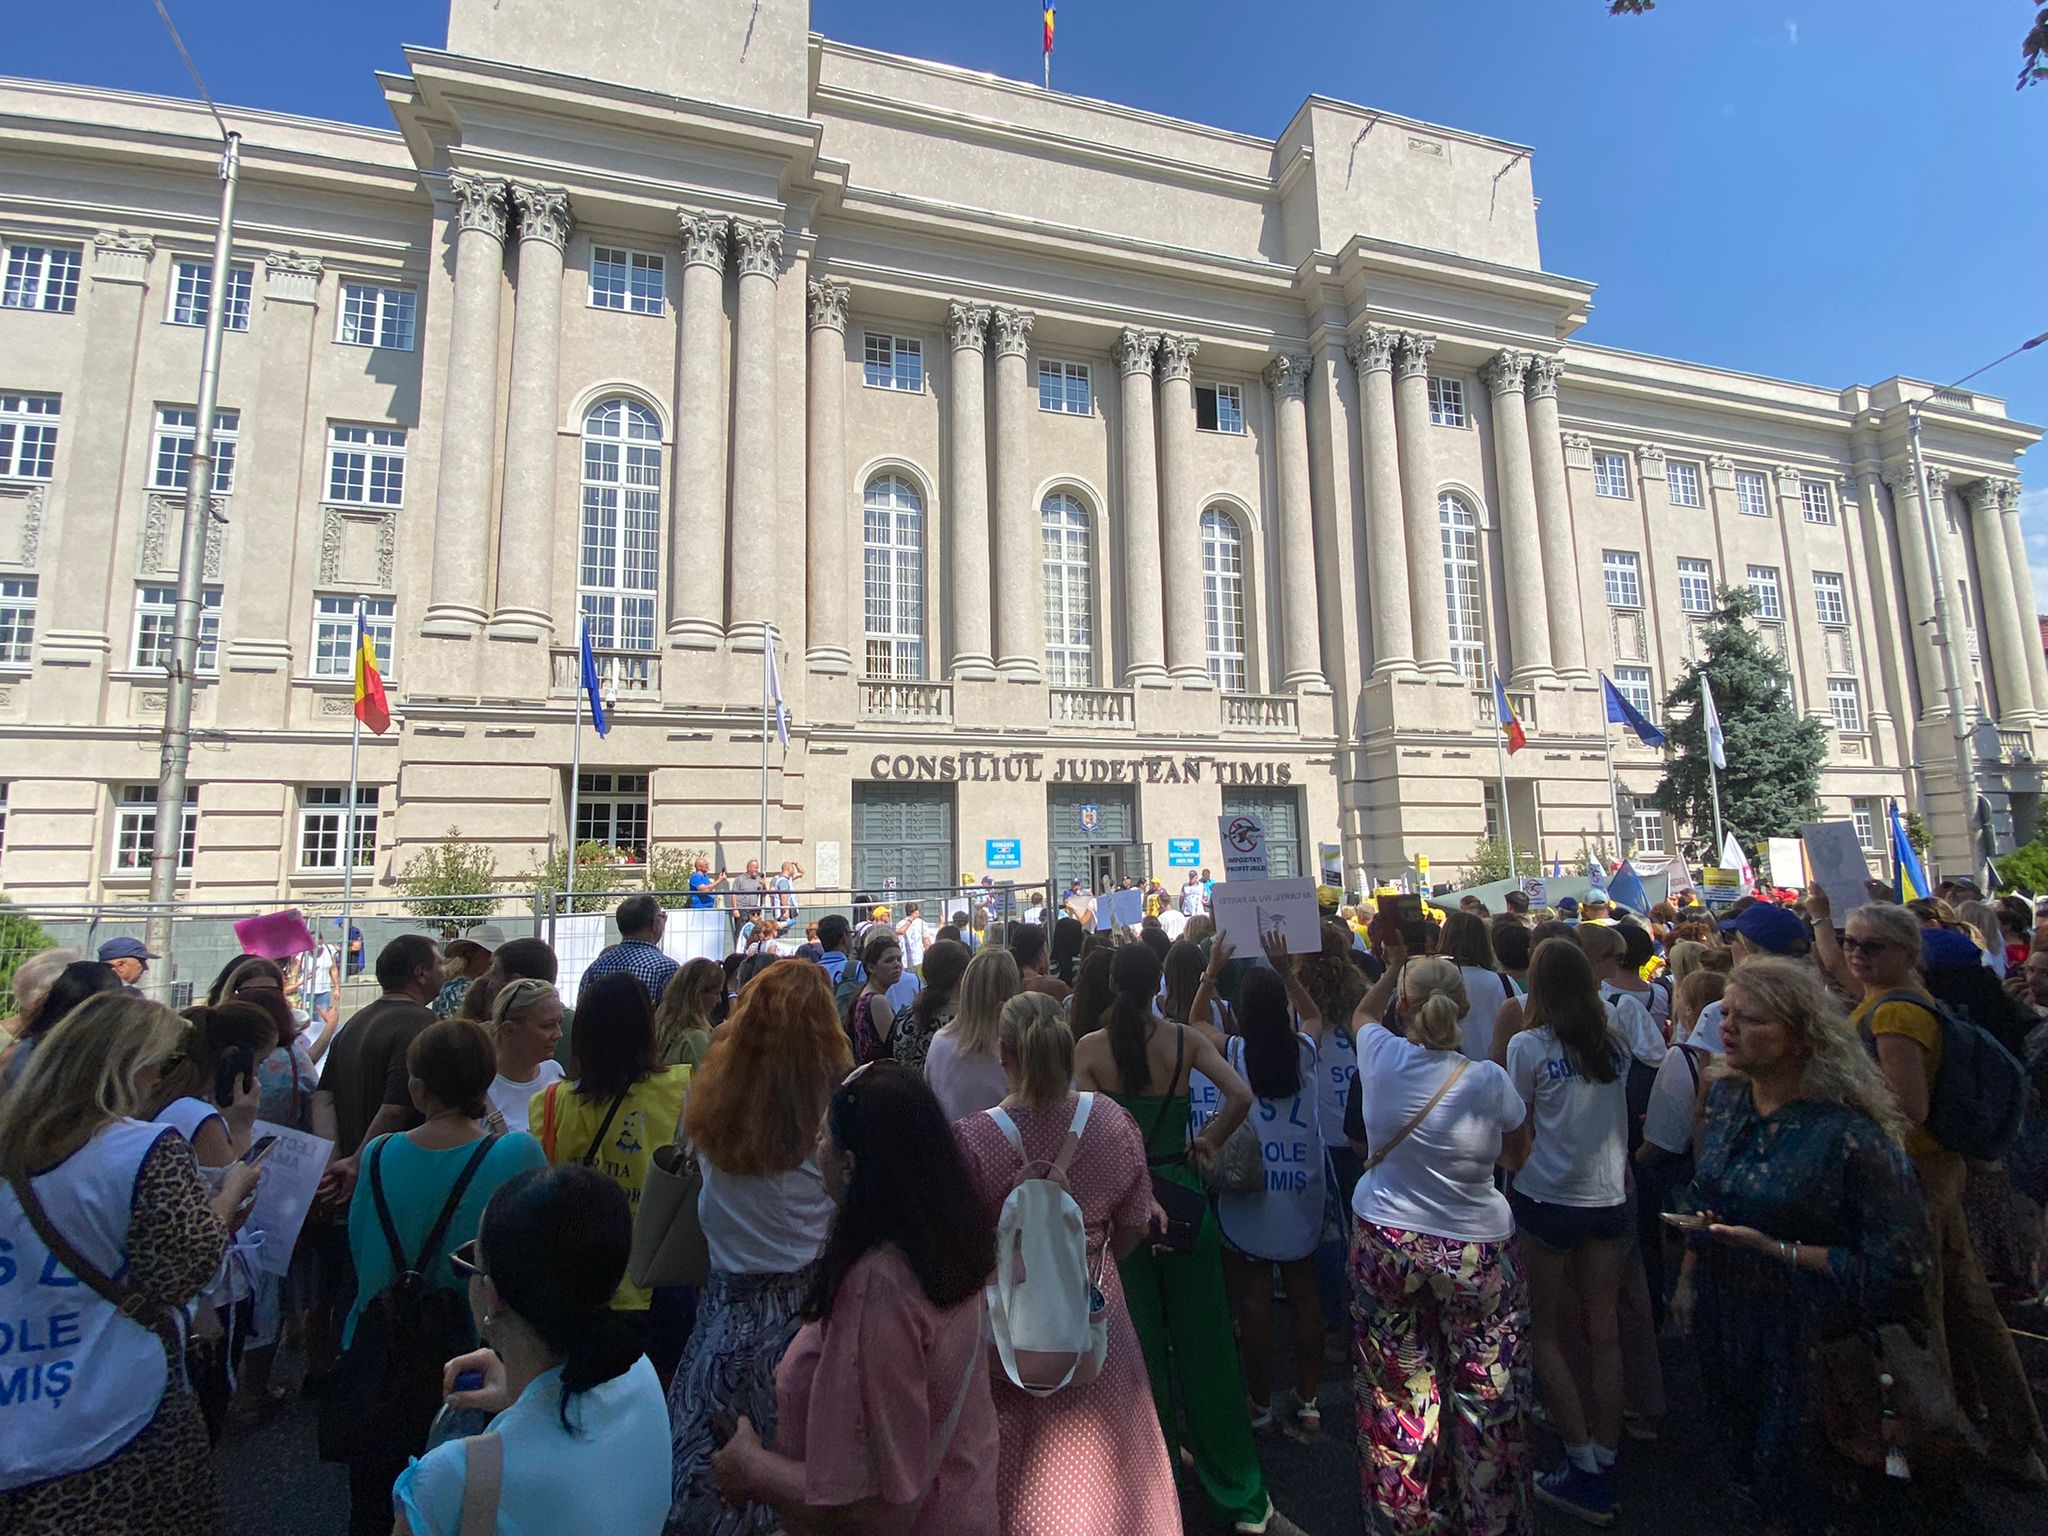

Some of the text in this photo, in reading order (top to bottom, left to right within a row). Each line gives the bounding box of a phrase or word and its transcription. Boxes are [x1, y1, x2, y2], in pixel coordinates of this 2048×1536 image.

[870, 754, 1042, 782] CONSILIUL
[1211, 761, 1292, 787] TIMIȘ
[1264, 1141, 1308, 1163] OLE
